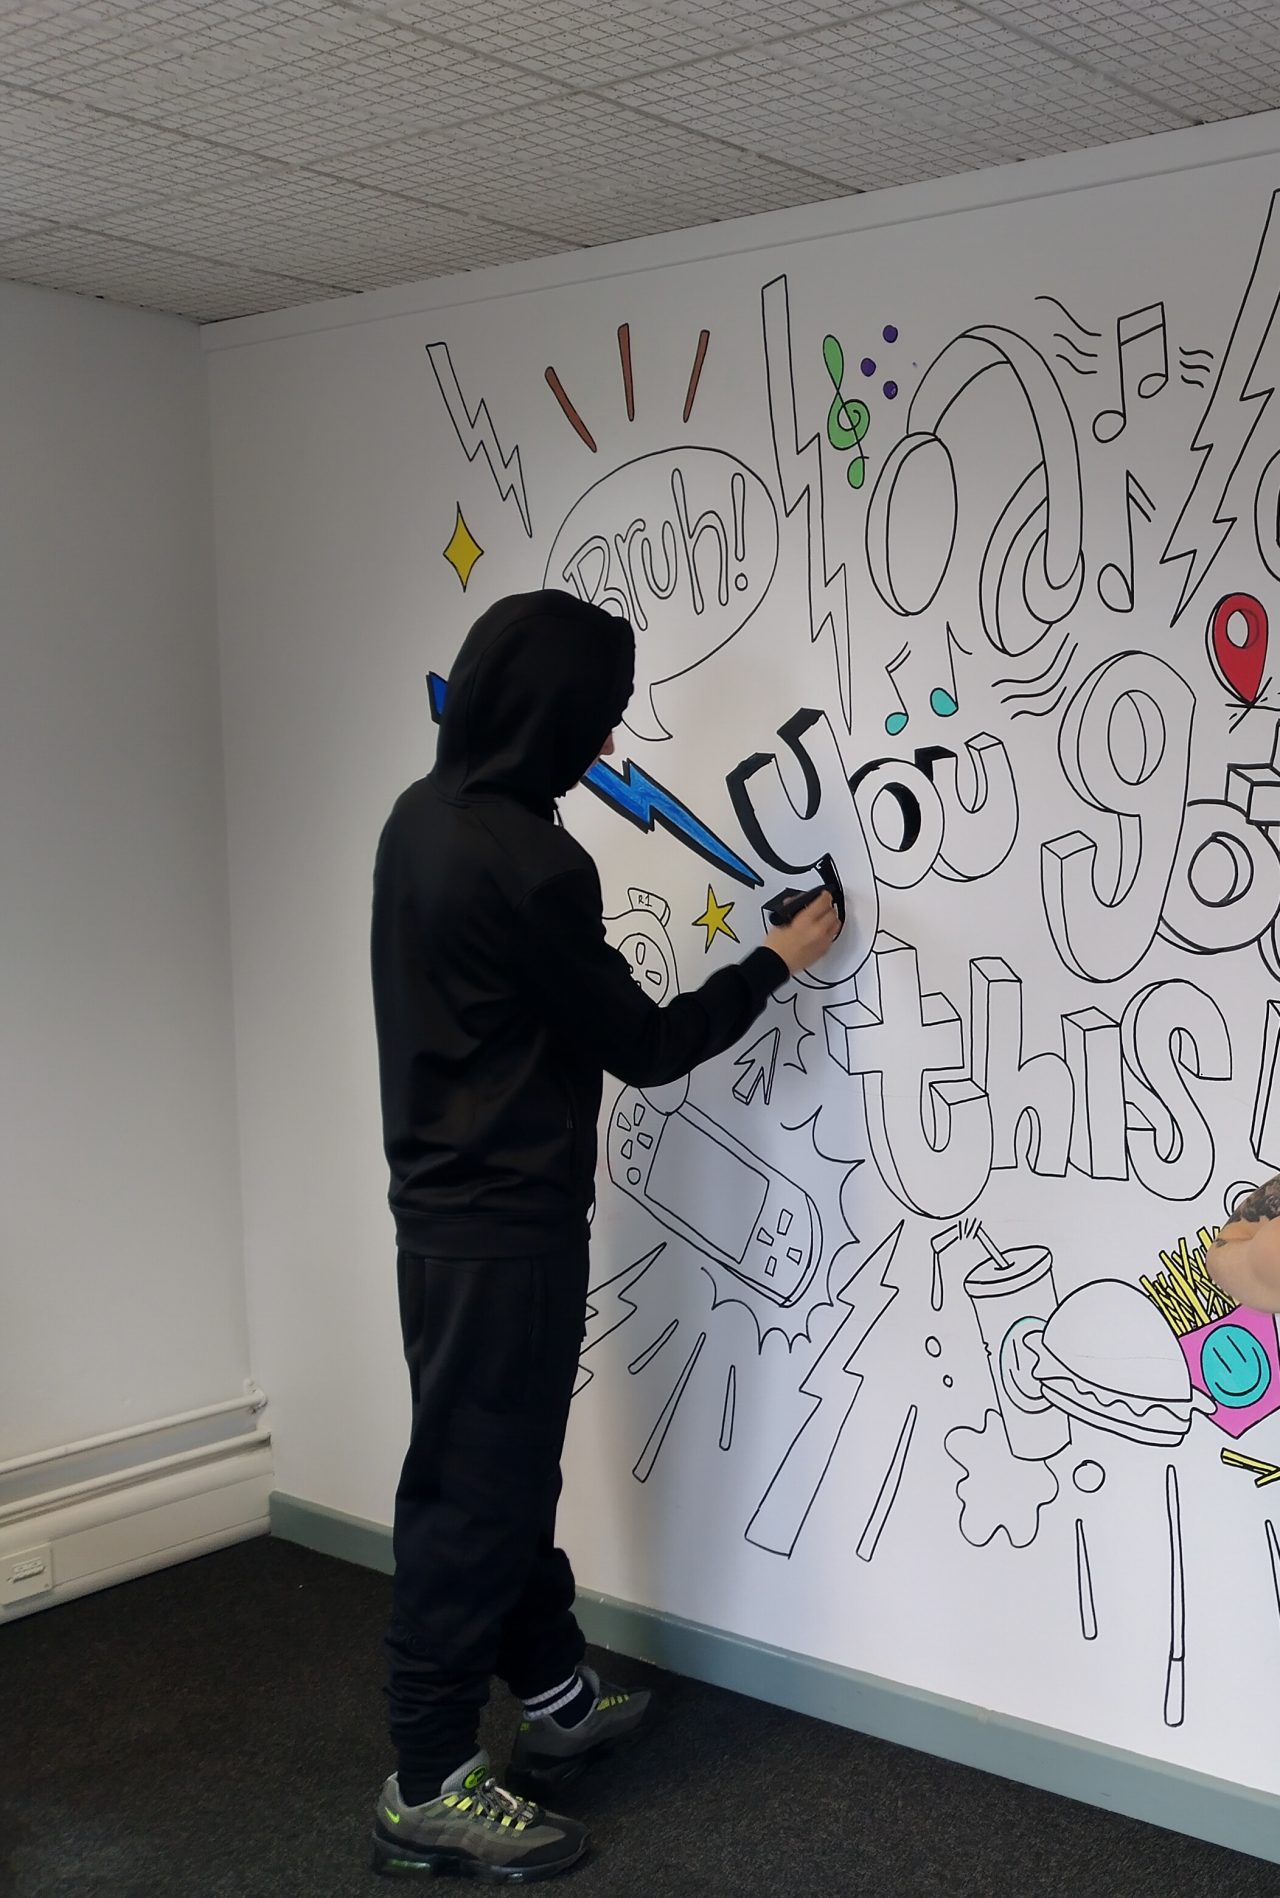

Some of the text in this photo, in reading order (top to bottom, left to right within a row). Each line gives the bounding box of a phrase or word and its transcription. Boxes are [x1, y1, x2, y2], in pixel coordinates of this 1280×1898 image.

[562, 467, 748, 631] Bruh!
[638, 893, 653, 907] R1
[726, 707, 1018, 988] you
